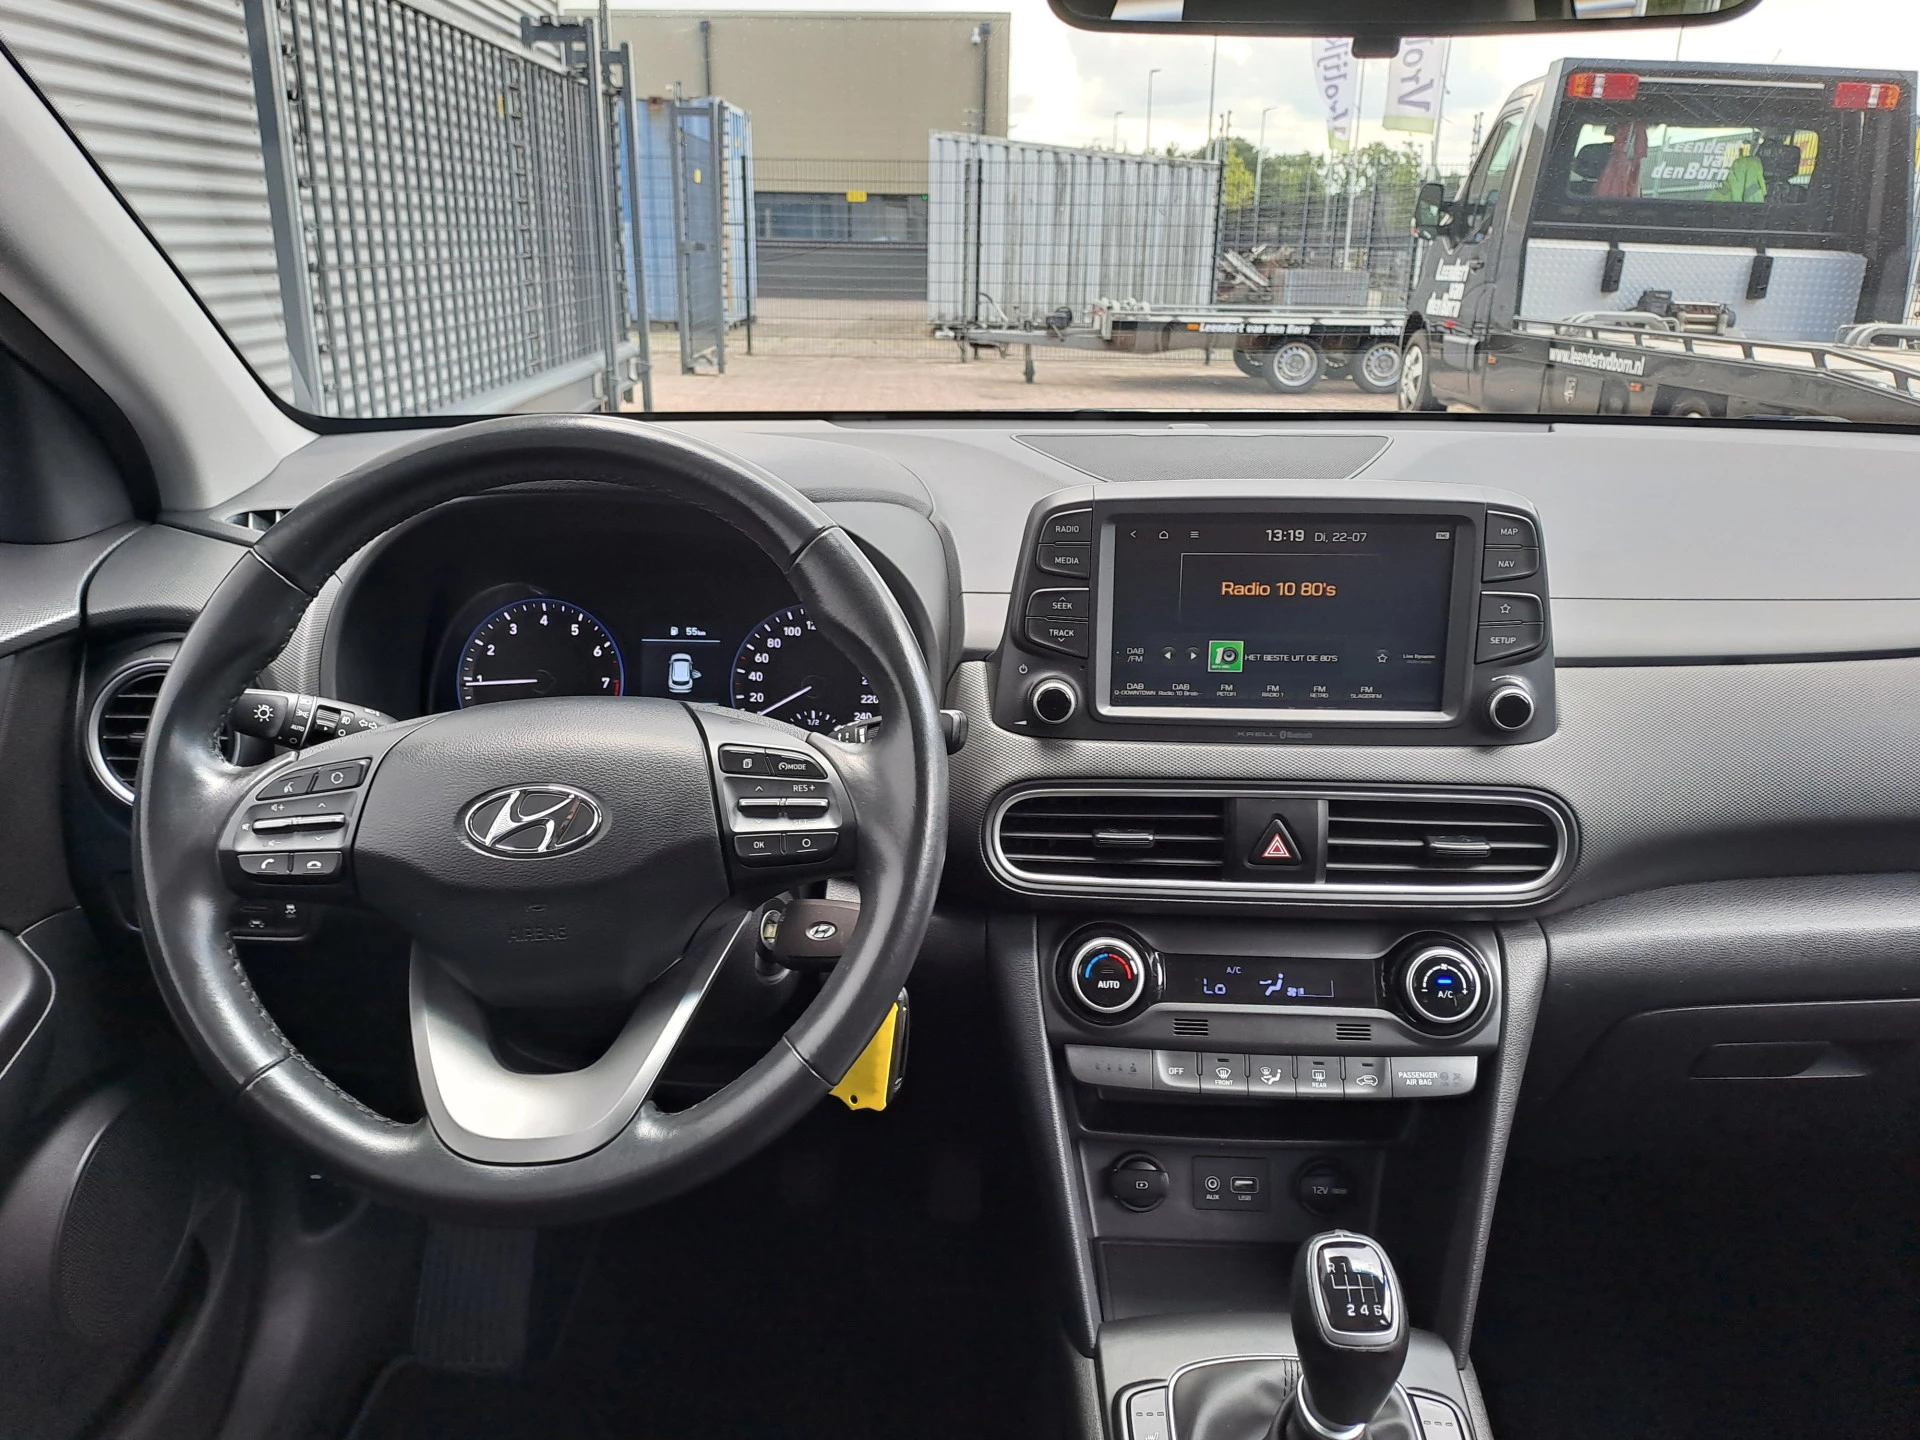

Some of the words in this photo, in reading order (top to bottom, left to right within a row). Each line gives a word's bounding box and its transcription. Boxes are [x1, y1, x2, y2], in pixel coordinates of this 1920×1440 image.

[1199, 323, 1245, 334] Leendert
[1246, 324, 1265, 334] van
[1265, 323, 1285, 334] den
[1286, 324, 1310, 335] Born
[1055, 525, 1080, 533] RADIO
[1265, 529, 1305, 541] 13:19
[1332, 532, 1367, 542] 22-07
[1054, 556, 1079, 565] MEDIA
[1498, 560, 1515, 568] NAV
[1221, 581, 1271, 596] Radio
[1276, 582, 1296, 596] 10
[1300, 582, 1336, 596] 80's
[1052, 602, 1073, 610] SEEK
[540, 615, 549, 626] 4
[509, 623, 518, 635] 3
[570, 624, 579, 636] 5
[783, 626, 802, 637] 100
[1049, 629, 1075, 637] TRACK
[767, 638, 781, 648] 80
[1490, 636, 1516, 644] SETUP
[487, 645, 495, 656] 2
[593, 646, 602, 657] 6
[1126, 647, 1144, 655] DAB
[754, 653, 769, 663] 60
[1291, 654, 1305, 662] UIT
[748, 671, 763, 681] 40
[601, 677, 610, 689] 7
[749, 692, 764, 702] 20
[290, 724, 305, 732] AUTO
[787, 763, 806, 771] MODE
[753, 841, 765, 849] OK
[1226, 966, 1242, 975] A/C
[1097, 980, 1120, 989] AUTO
[1437, 990, 1454, 999] A/C
[1168, 1067, 1184, 1075] OFF
[1398, 1071, 1438, 1079] PASSENGER
[1311, 1081, 1327, 1089] REAR
[1312, 1186, 1329, 1195] 12V
[1328, 1263, 1336, 1273] R
[1346, 1303, 1356, 1317] 2
[1360, 1304, 1369, 1316] 4
[1373, 1304, 1382, 1316] 6
